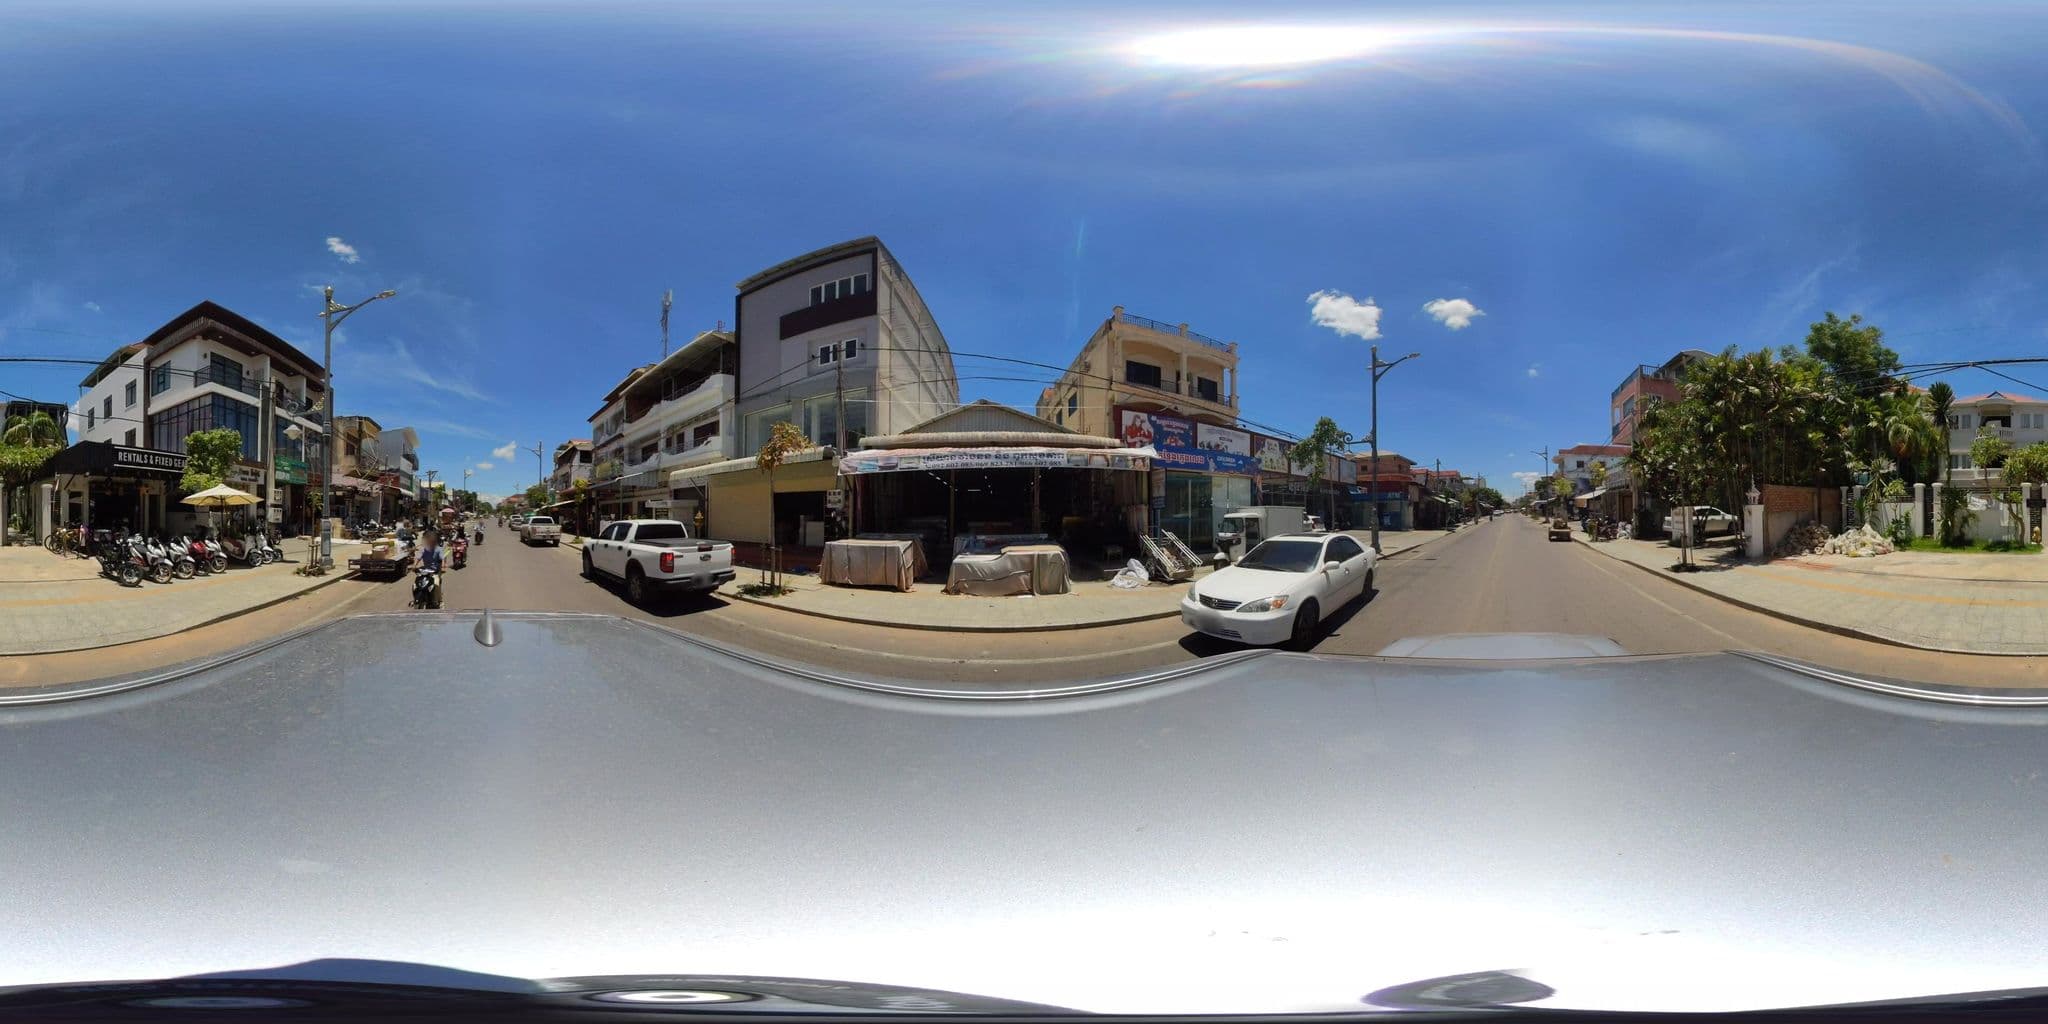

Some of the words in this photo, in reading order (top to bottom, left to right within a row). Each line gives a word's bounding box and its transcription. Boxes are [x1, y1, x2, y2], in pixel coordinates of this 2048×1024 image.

[118, 452, 148, 464] RENTALS
[149, 454, 154, 464] &
[155, 456, 173, 466] FIXED
